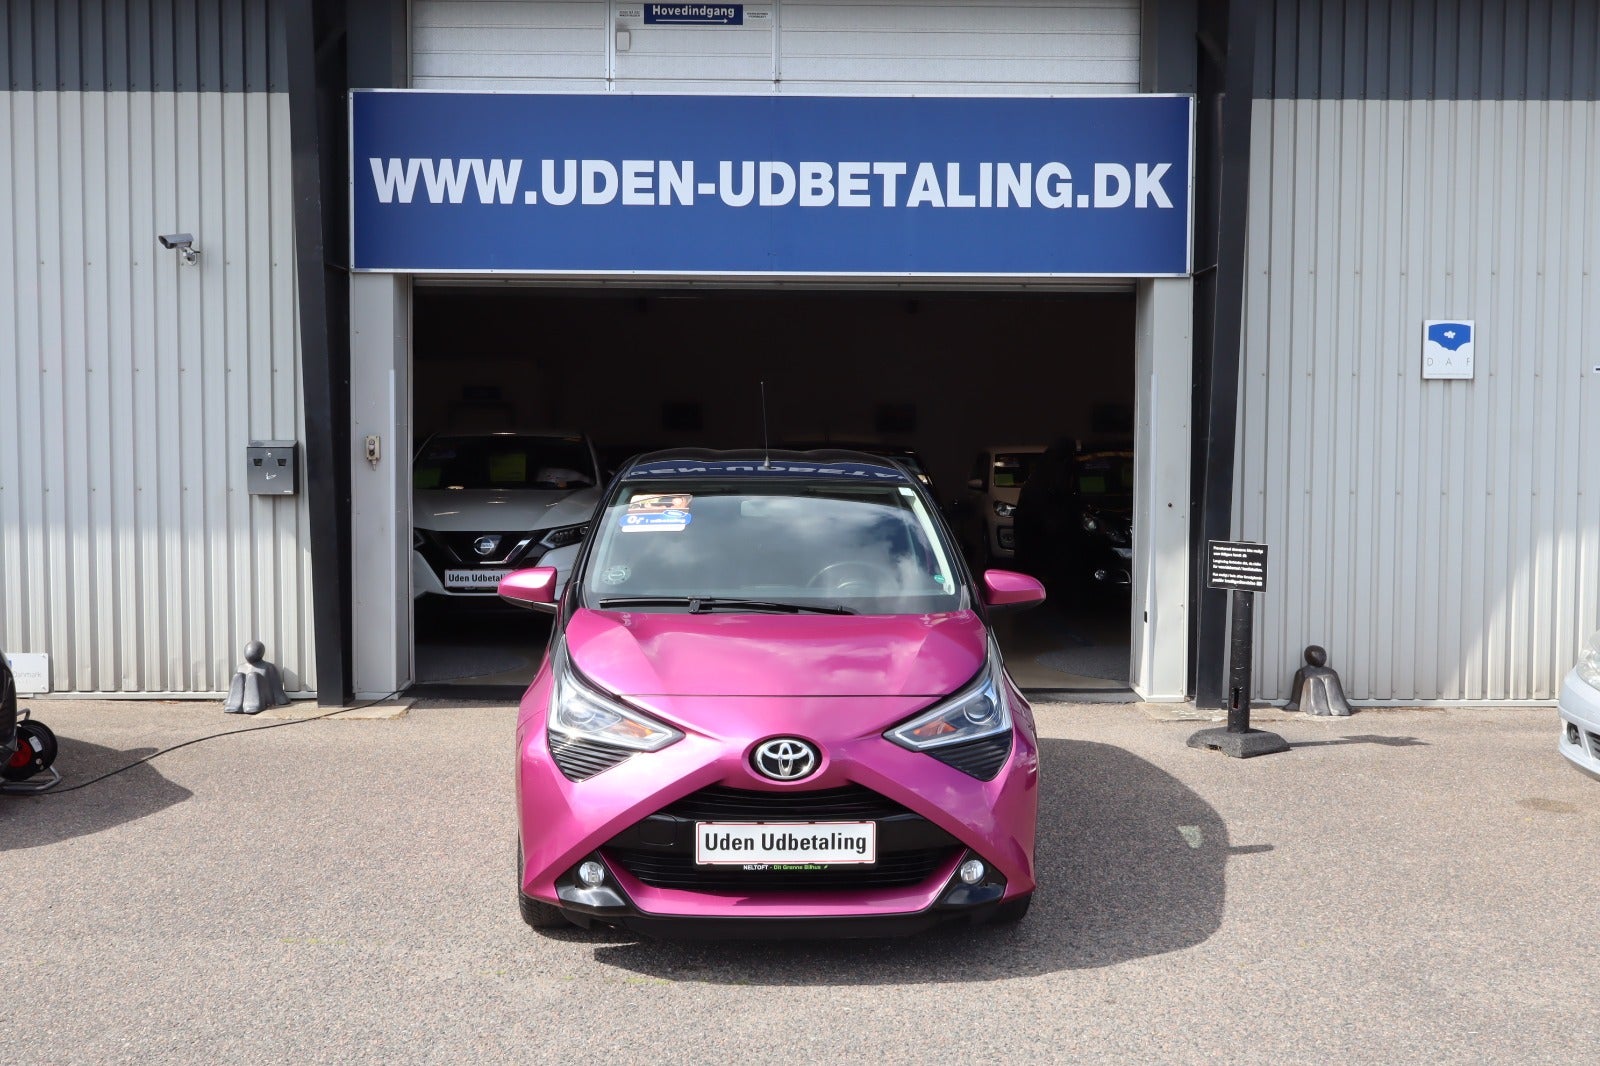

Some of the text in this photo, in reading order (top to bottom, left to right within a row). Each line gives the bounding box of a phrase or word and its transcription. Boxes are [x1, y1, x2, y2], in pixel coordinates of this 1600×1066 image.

[652, 5, 735, 18] Hovedindgang
[369, 157, 1175, 210] WWW.UDEN-UDBETALING.DK
[448, 574, 469, 582] Uden
[705, 833, 867, 854] Uden Udbetaling
